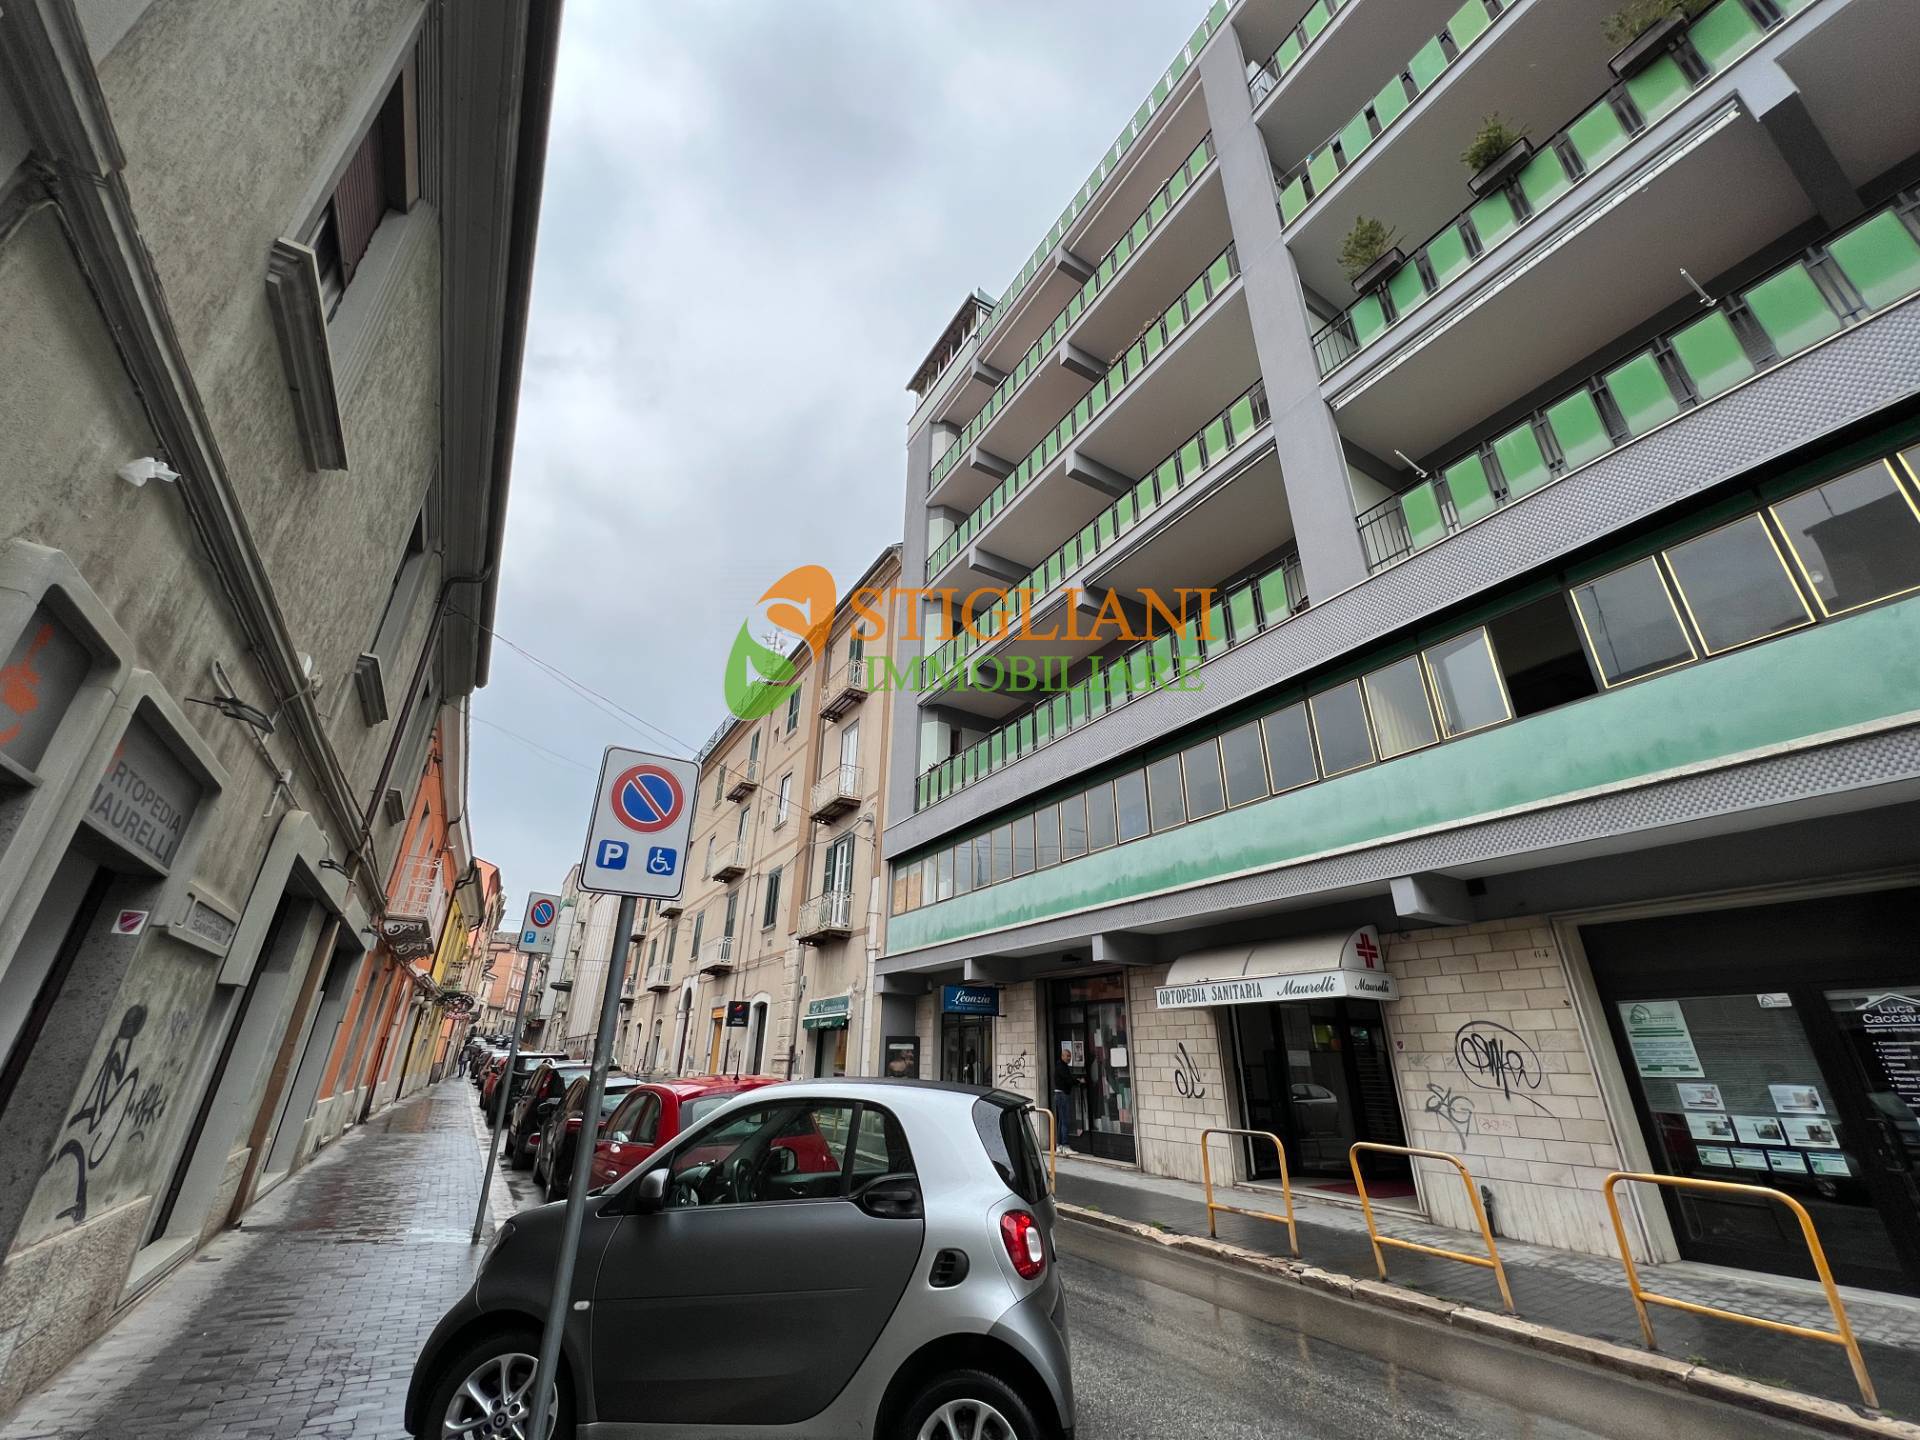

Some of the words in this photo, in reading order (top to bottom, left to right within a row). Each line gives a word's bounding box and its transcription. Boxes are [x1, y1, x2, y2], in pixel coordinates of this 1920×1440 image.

[109, 760, 182, 835] RTOPEDIA
[603, 843, 624, 866] P
[1159, 987, 1207, 1005] ORTOPEDIA
[1211, 982, 1263, 1001] SANITARIA
[1276, 975, 1335, 997] Maurelli
[1354, 978, 1389, 993] Maurelli
[951, 989, 991, 1005] Leonzia
[1877, 1004, 1916, 1014] Luca
